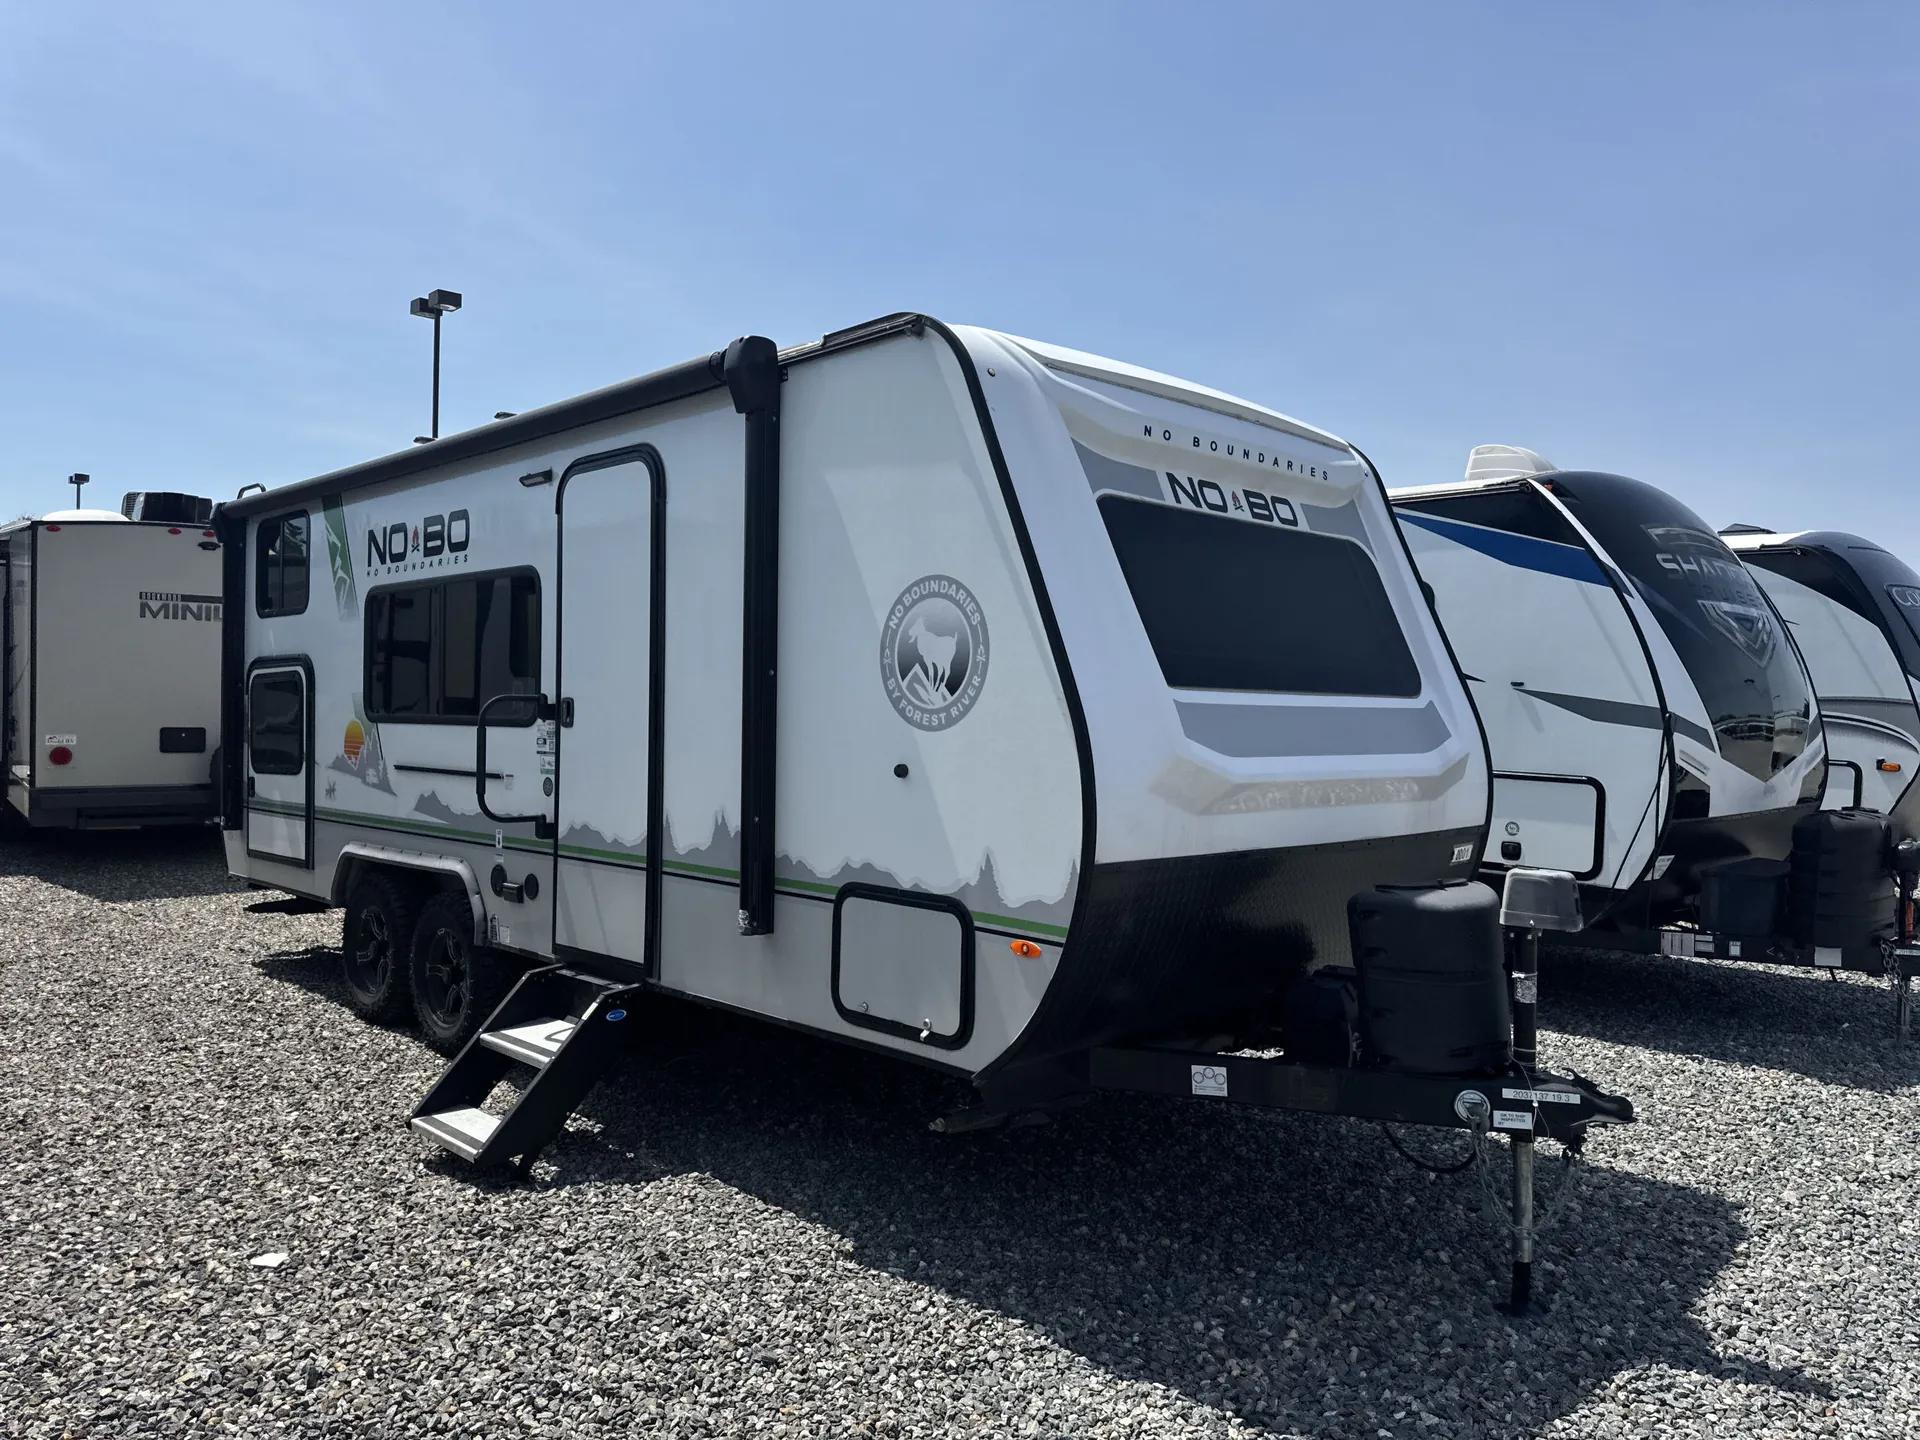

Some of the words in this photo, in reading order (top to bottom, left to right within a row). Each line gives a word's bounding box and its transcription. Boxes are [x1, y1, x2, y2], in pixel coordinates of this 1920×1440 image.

[1144, 425, 1171, 441] NO
[1193, 436, 1328, 481] BOUNDARIES
[367, 569, 379, 577] NO
[387, 553, 469, 574] BOUNDARIES
[889, 605, 904, 629] NO
[902, 580, 981, 625] BOUNDARIES
[887, 678, 901, 699] BY
[899, 699, 947, 726] FOREST
[950, 675, 981, 718] RIVER
